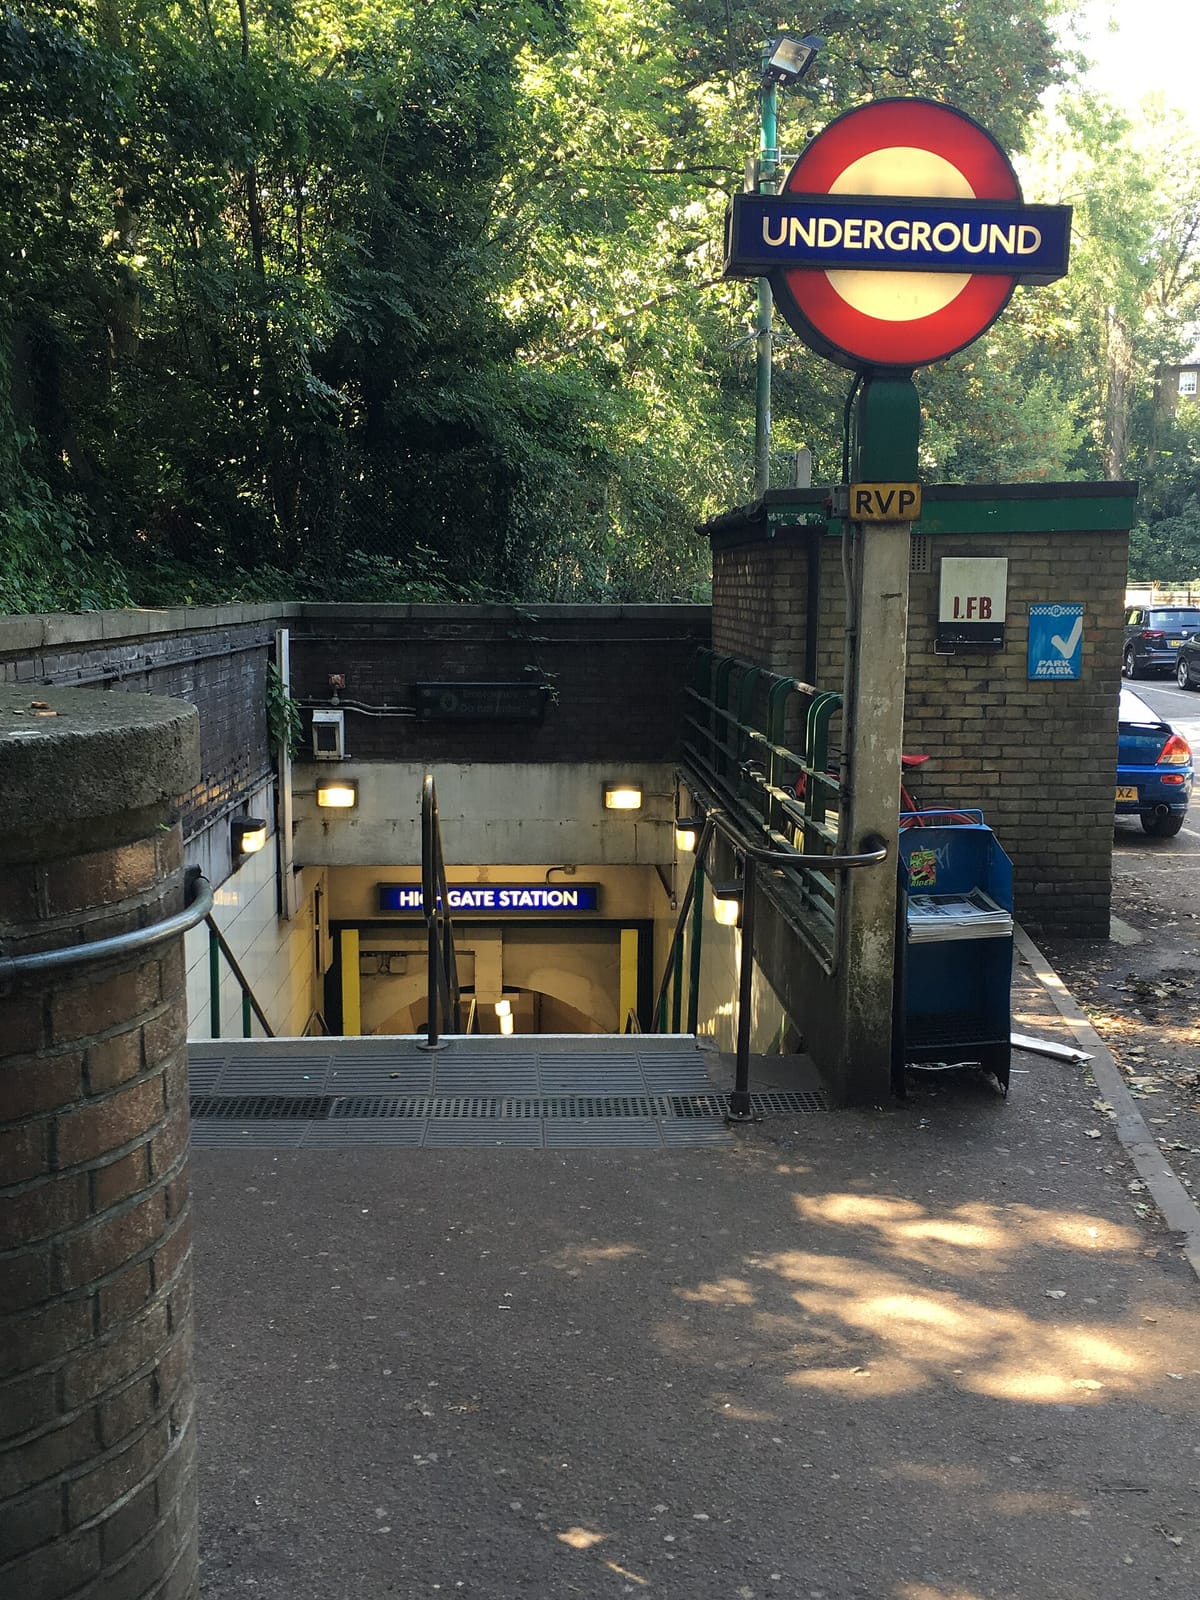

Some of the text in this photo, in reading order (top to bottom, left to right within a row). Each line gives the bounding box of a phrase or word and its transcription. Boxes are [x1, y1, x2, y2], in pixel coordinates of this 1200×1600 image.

[762, 216, 1041, 254] UNDERGROUND
[855, 489, 915, 514] RVP
[400, 891, 578, 906] HIGATE STATION
